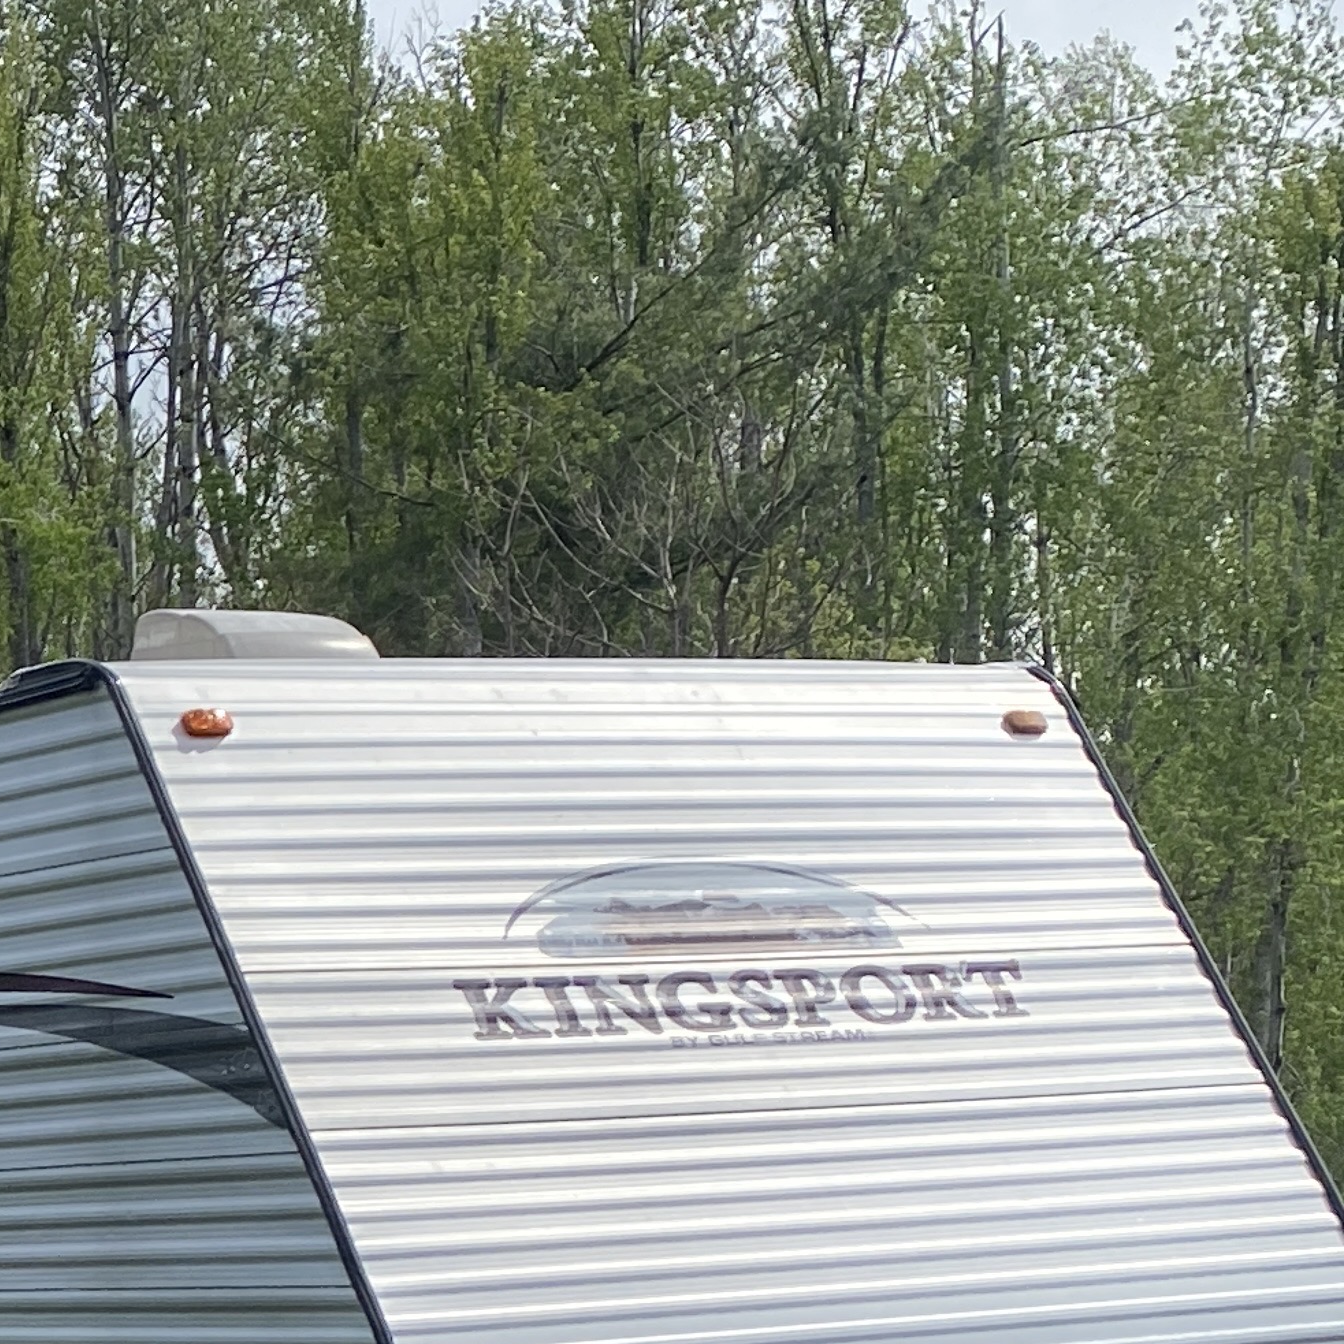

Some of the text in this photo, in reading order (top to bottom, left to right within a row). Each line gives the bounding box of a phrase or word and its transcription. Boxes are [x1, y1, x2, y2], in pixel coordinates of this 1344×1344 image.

[452, 958, 1030, 1041] KINGSPORT
[669, 1035, 698, 1049] BY
[771, 1028, 867, 1044] STREAM
